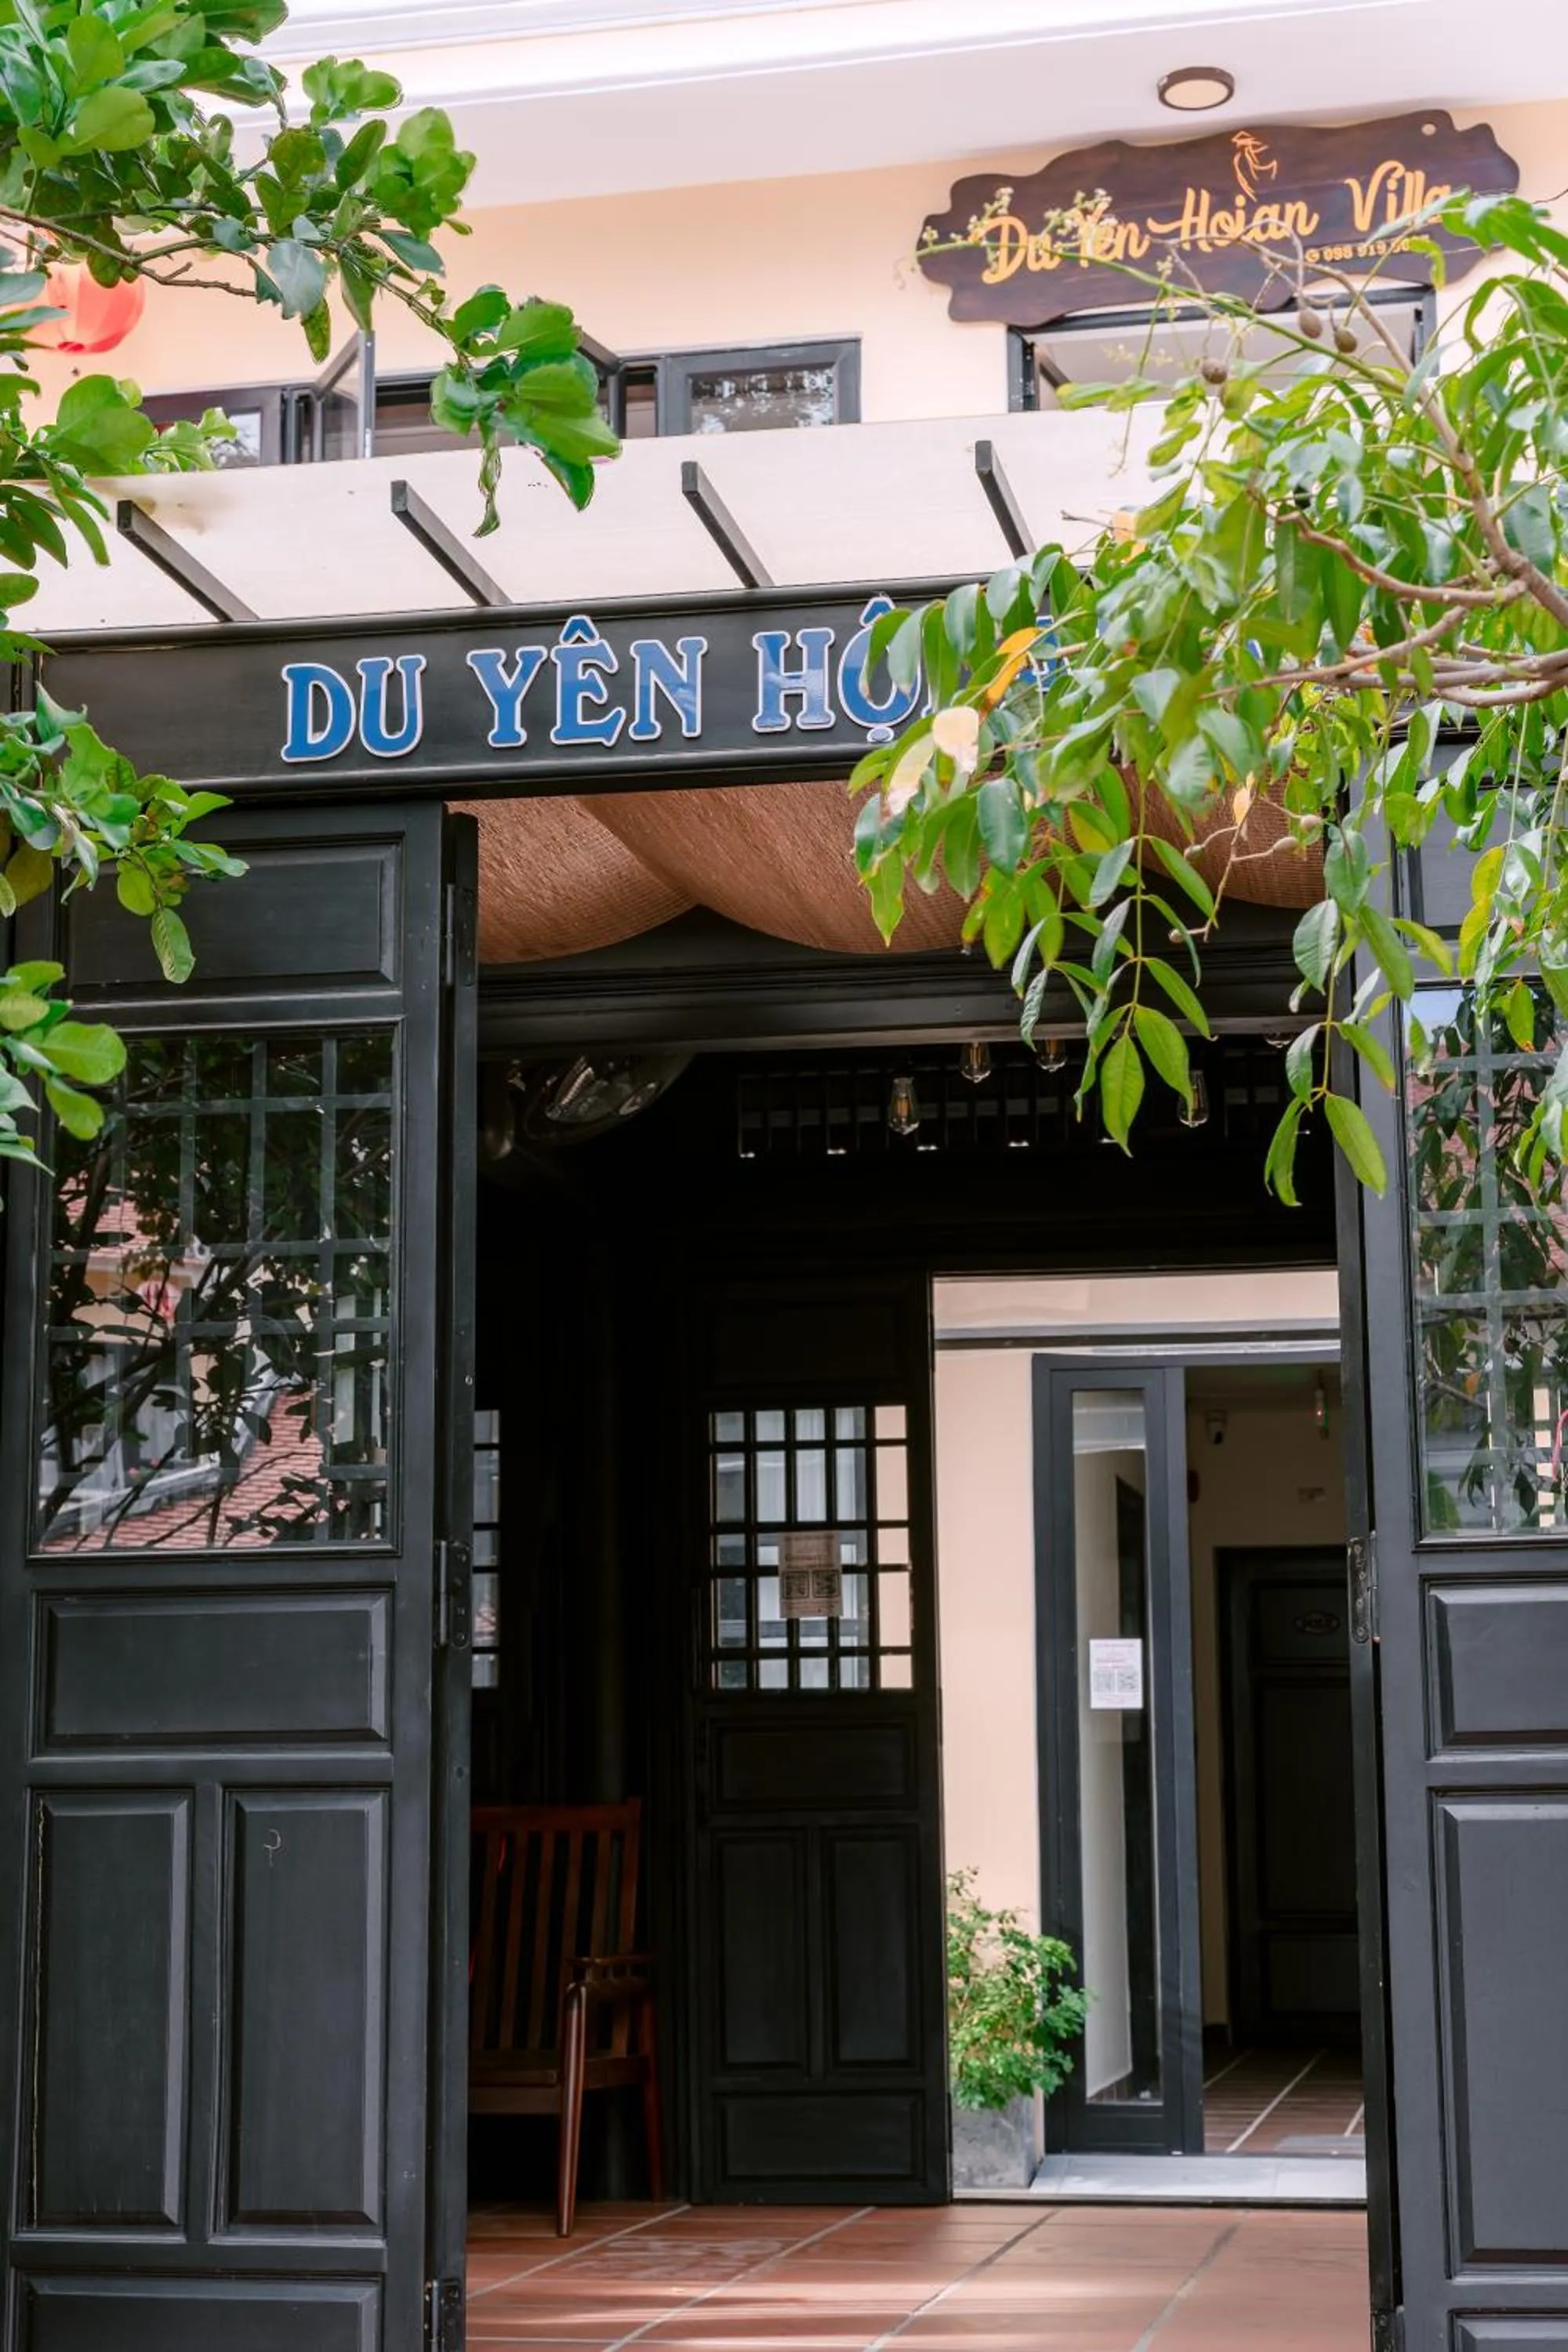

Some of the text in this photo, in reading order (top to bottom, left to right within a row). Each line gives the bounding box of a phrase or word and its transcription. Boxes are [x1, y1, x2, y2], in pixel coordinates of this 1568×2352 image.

[968, 215, 1062, 285] Du
[1344, 160, 1452, 234] Villa
[281, 654, 426, 764] DU
[466, 614, 709, 748] YÊN
